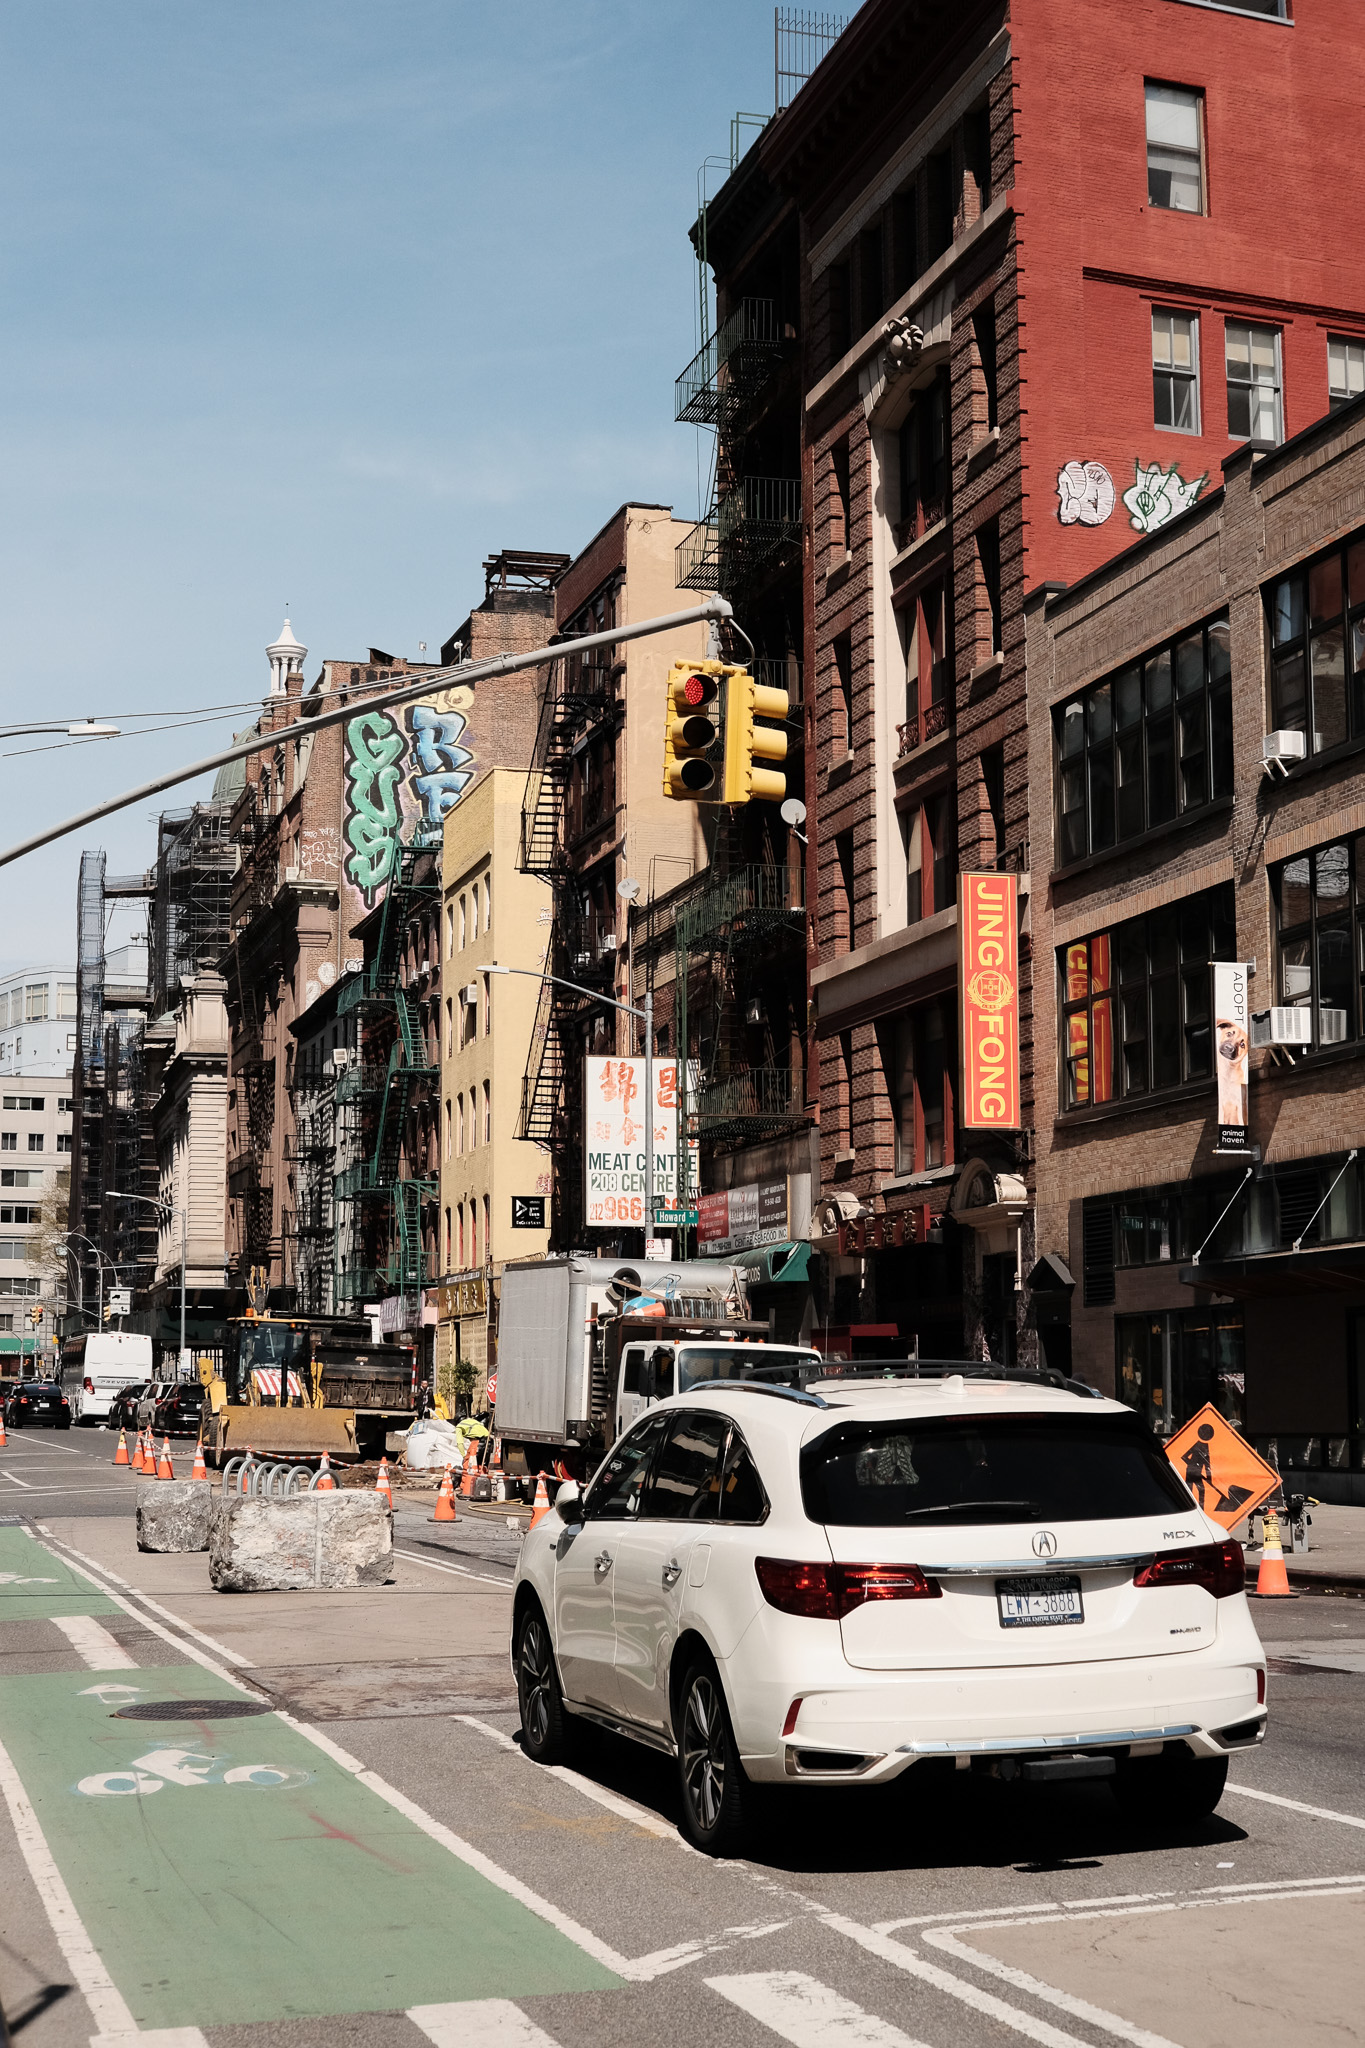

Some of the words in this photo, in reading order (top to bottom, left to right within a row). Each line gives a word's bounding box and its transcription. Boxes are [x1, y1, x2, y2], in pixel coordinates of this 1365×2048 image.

[976, 882, 1004, 967] JING
[1233, 971, 1244, 1024] ADOPT
[978, 1015, 1006, 1118] FONG
[1222, 1129, 1245, 1137] animal
[1222, 1136, 1245, 1144] haven
[588, 1152, 631, 1171] MEAT
[591, 1172, 617, 1191] 208
[589, 1202, 603, 1220] 212
[659, 1211, 686, 1222] Howard
[1163, 1530, 1196, 1540] MDX
[1037, 1581, 1060, 1590] YORK
[1006, 1592, 1030, 1615] EWY
[1041, 1590, 1075, 1613] 3888
